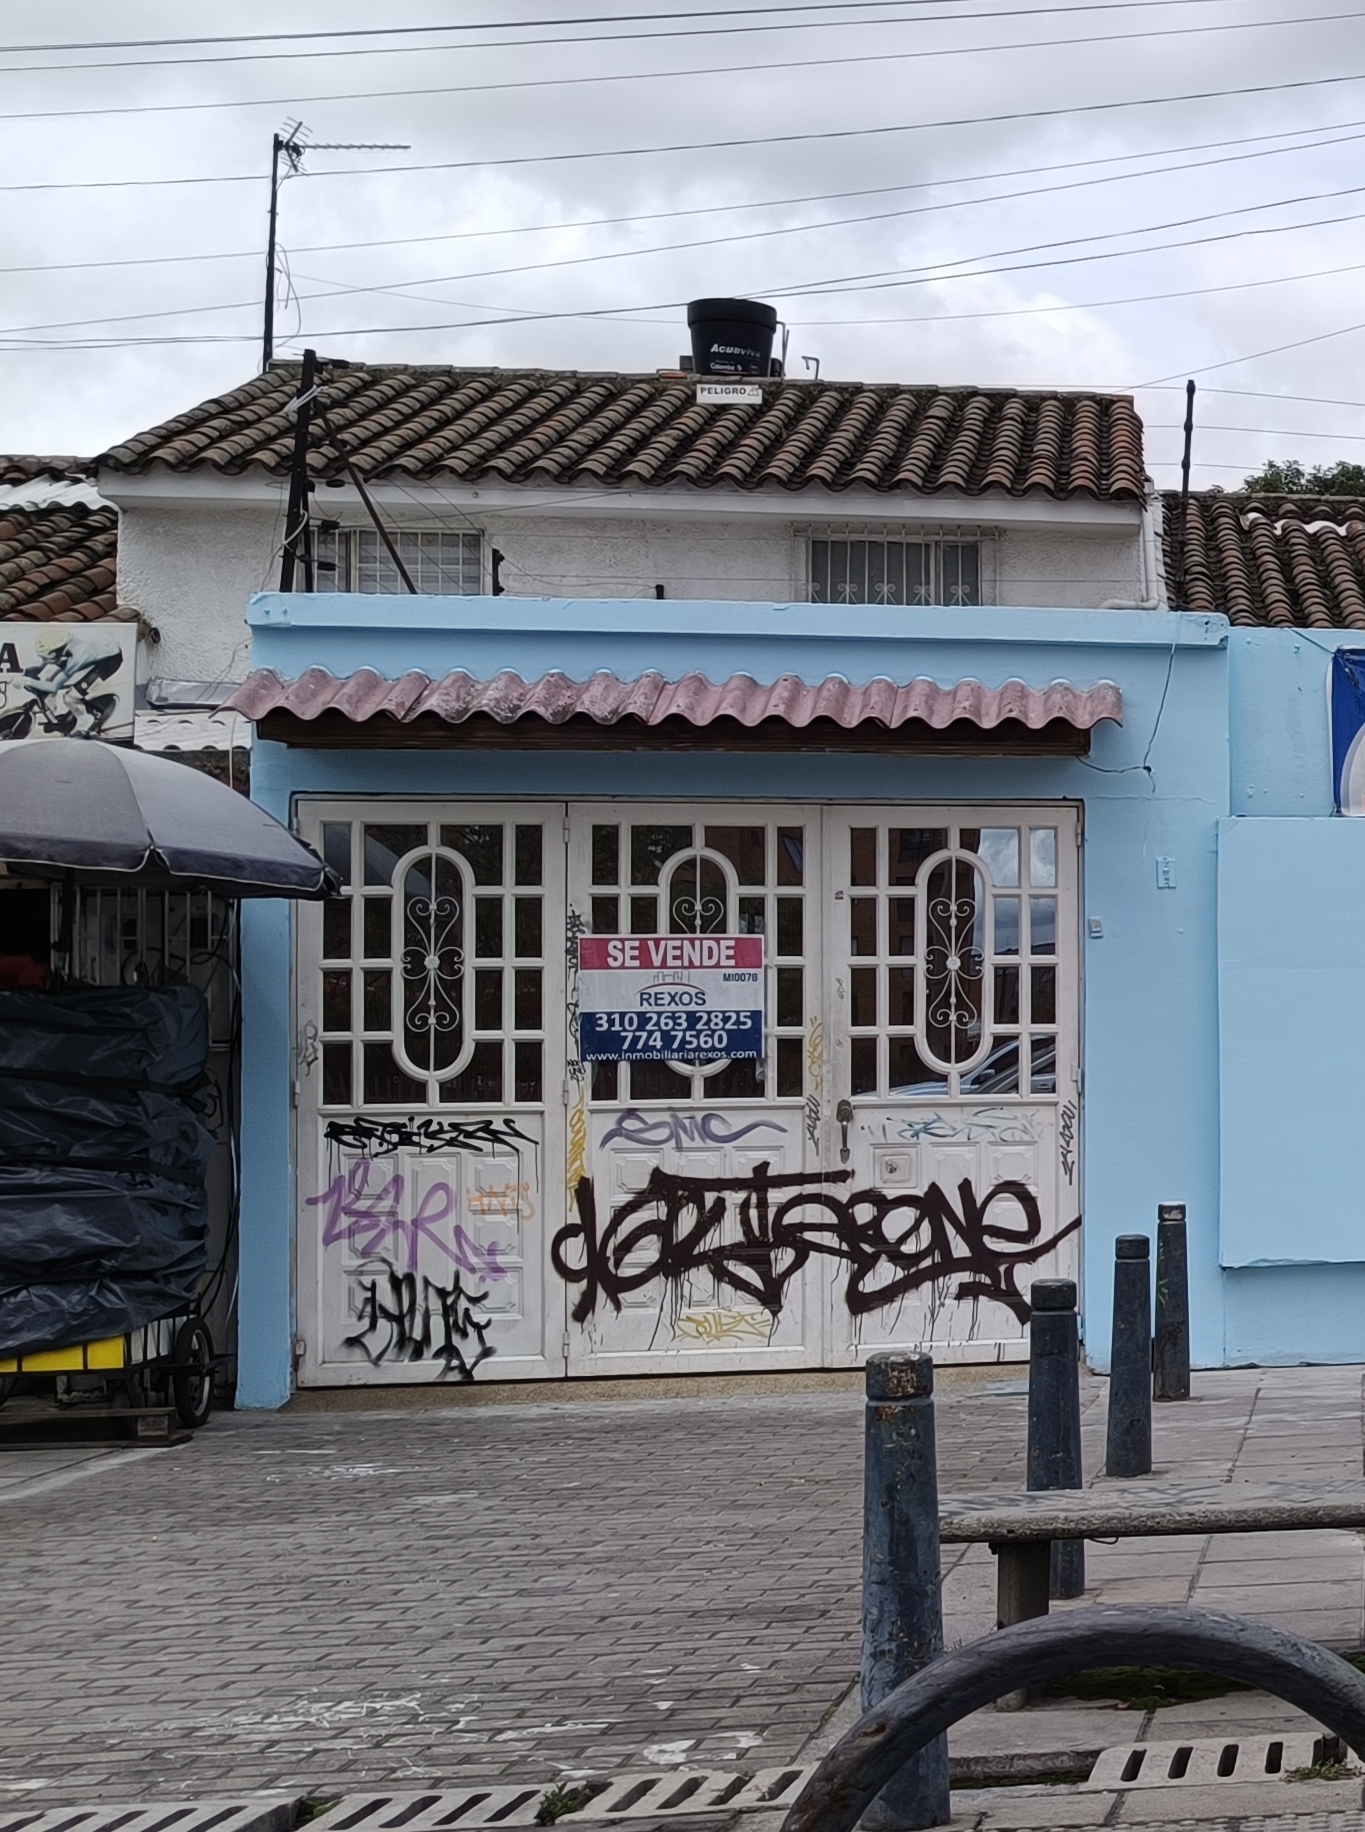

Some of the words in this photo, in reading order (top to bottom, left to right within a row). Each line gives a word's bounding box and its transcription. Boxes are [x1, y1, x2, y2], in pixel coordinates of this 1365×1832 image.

[700, 386, 746, 395] PELIGRO
[607, 940, 640, 967] SE
[648, 939, 736, 967] VENDE
[640, 991, 707, 1007] REXOS
[595, 1013, 639, 1031] 310
[645, 1012, 688, 1030] 263
[695, 1012, 752, 1029] 2825
[620, 1031, 663, 1050] 774
[670, 1031, 728, 1049] 7560
[586, 1050, 757, 1061] www.inmobiliariarexos.com
